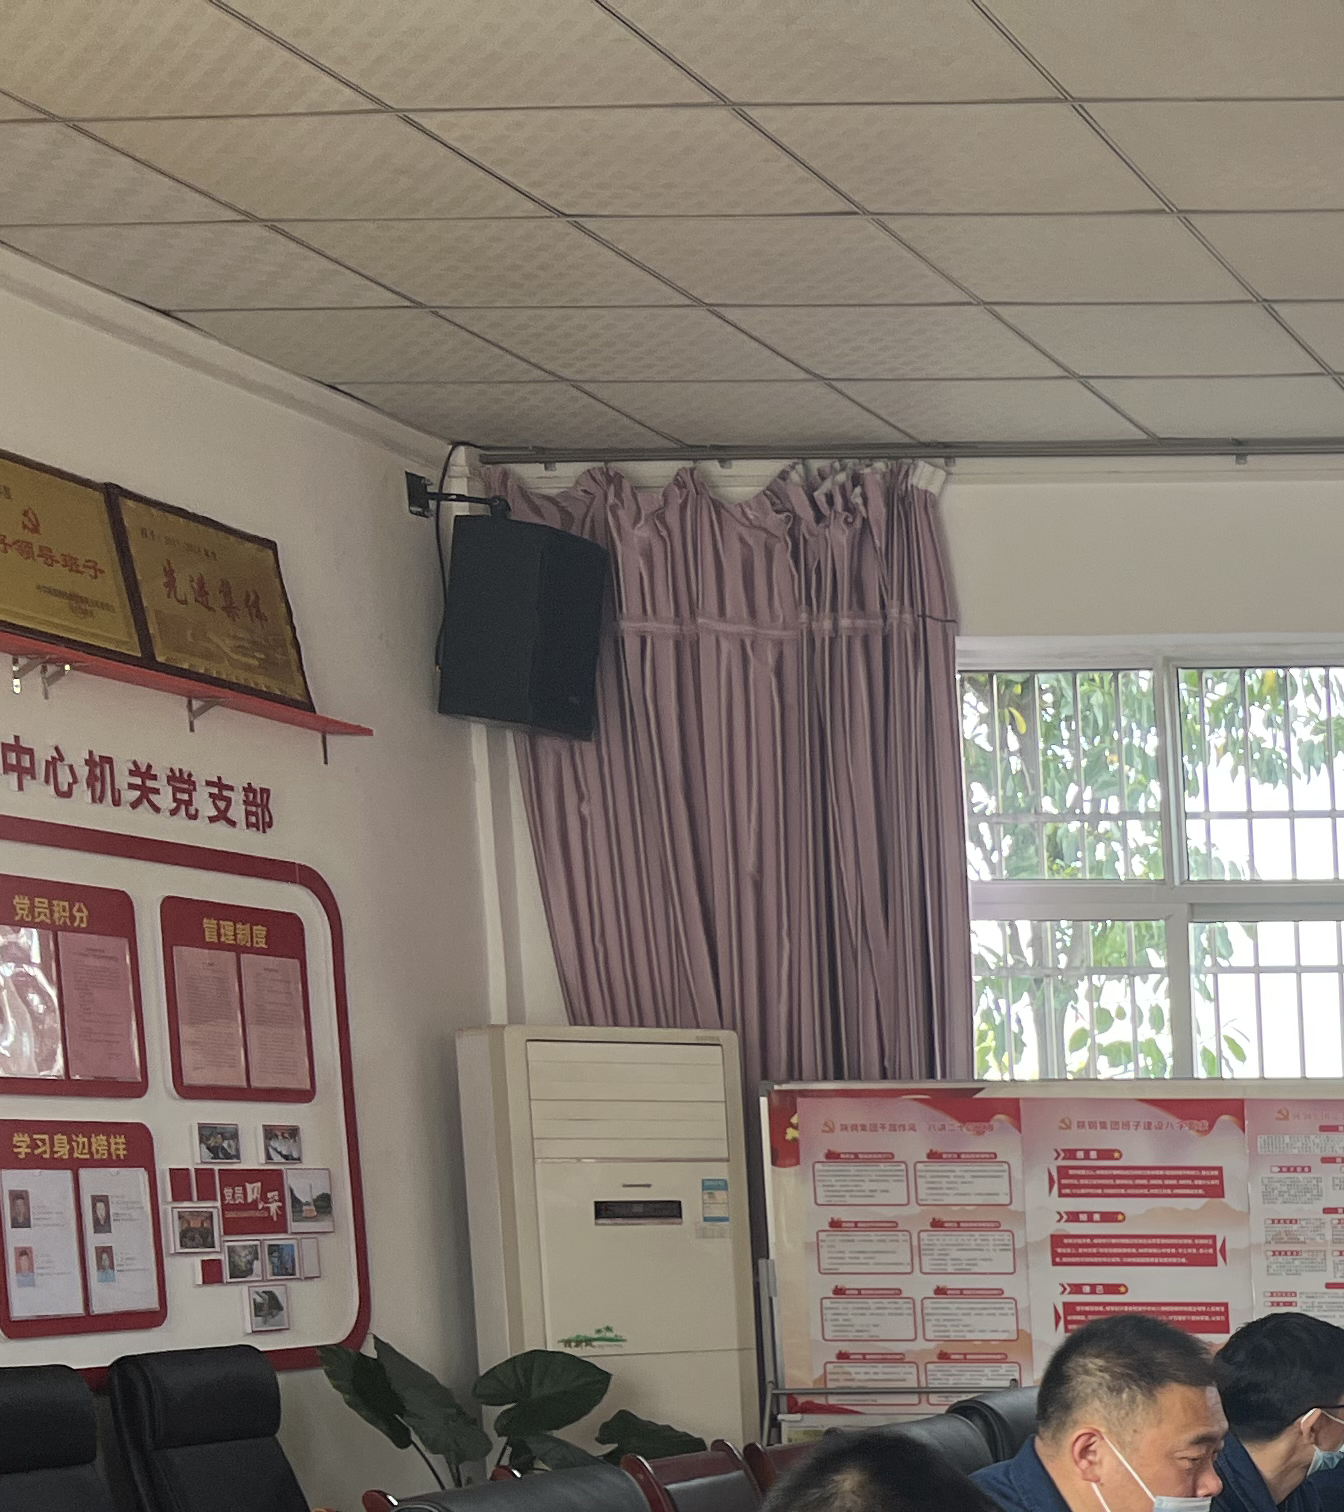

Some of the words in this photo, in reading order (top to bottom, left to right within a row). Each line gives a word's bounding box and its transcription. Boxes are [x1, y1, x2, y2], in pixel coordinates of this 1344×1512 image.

[1, 735, 273, 834] 中心机关党支部
[12, 894, 89, 928] 党员积分
[202, 917, 268, 949] 管理制度
[12, 1132, 128, 1160] 学习身边榜样
